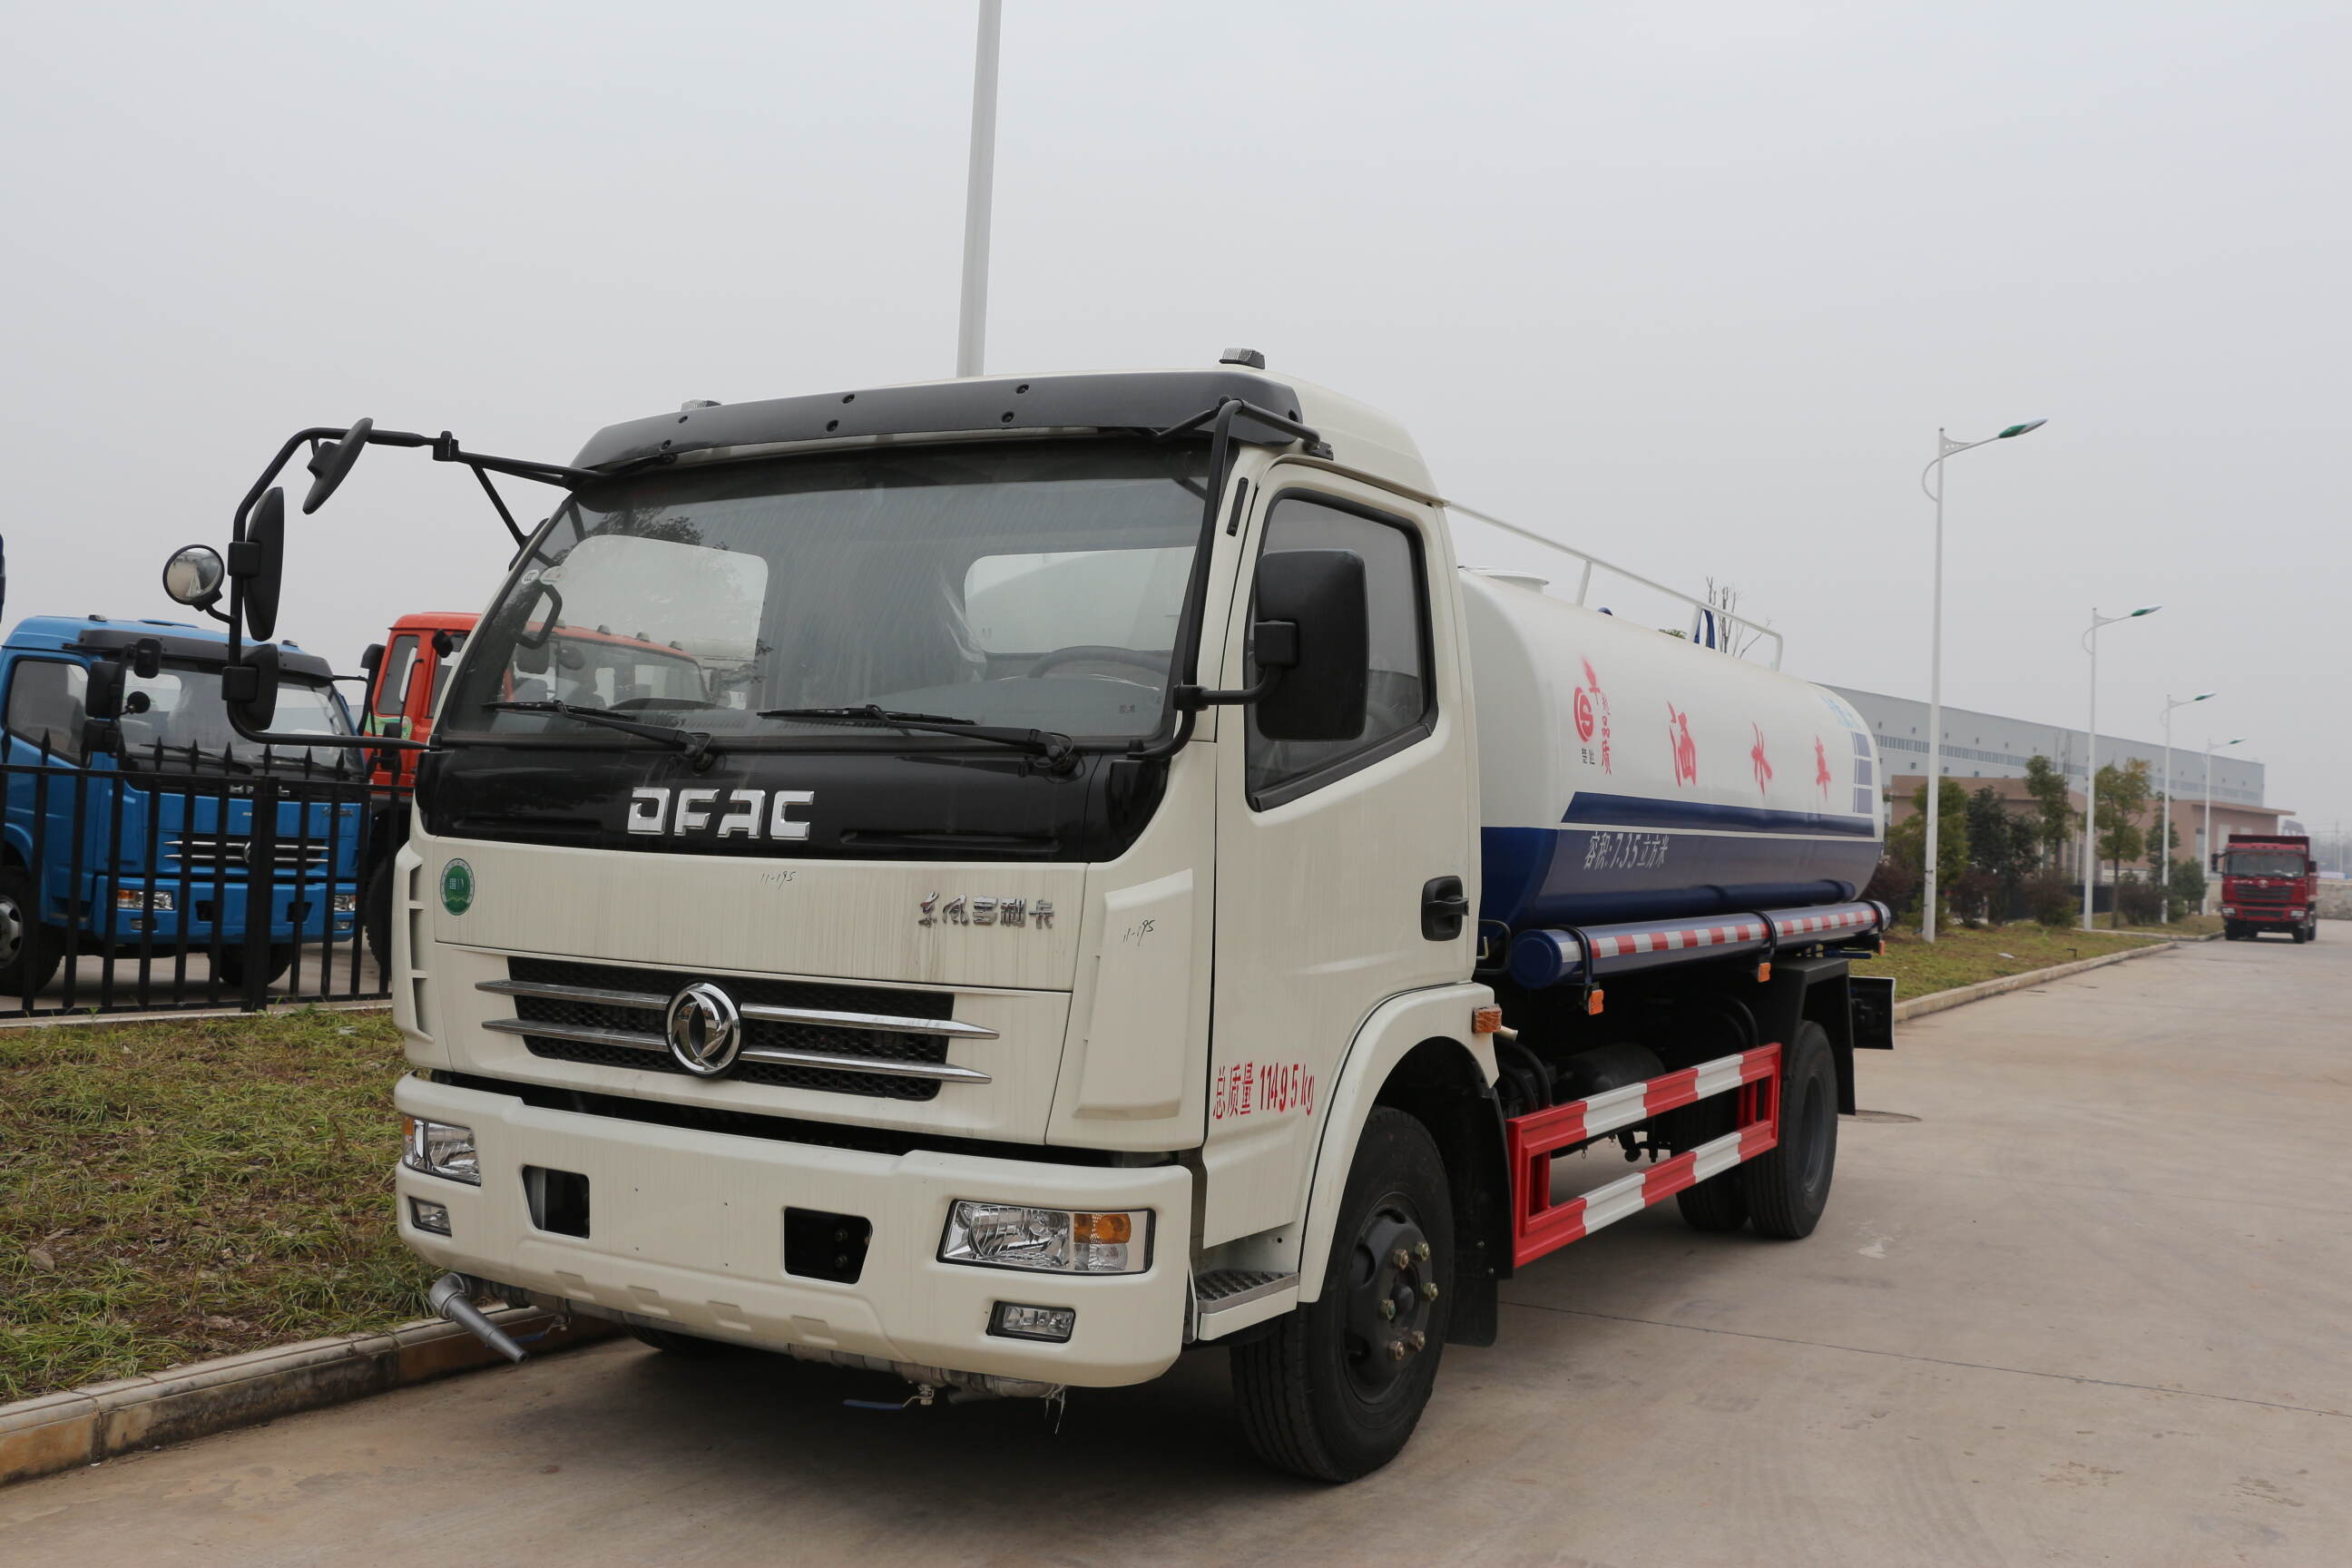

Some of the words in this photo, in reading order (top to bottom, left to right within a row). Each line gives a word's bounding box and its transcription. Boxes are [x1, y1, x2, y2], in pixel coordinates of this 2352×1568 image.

[627, 787, 815, 841] DFAC
[917, 890, 1055, 929] 东风多利卡
[1212, 1061, 1254, 1121] 总质量
